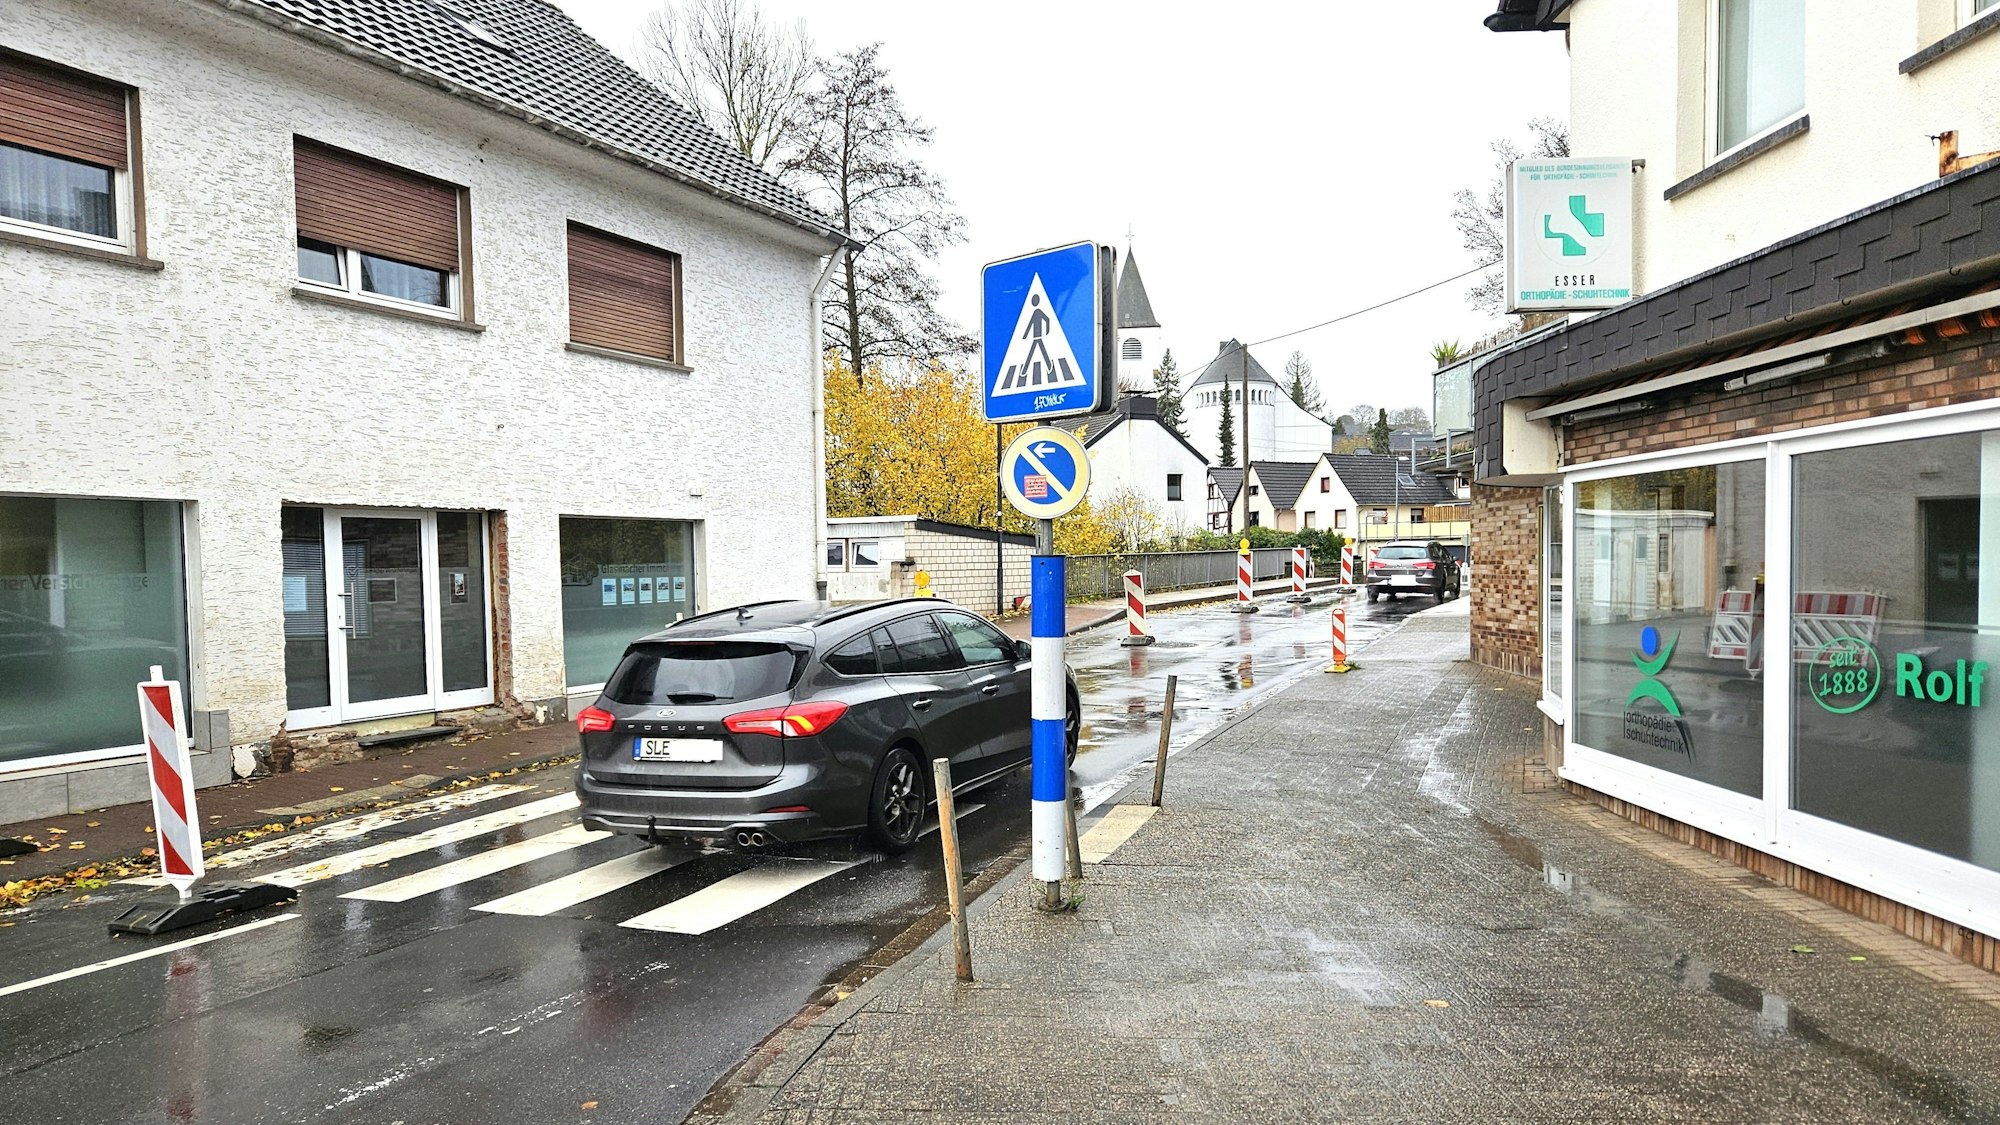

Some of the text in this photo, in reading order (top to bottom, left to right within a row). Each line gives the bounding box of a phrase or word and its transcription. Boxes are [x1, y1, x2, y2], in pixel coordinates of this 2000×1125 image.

[1555, 274, 1595, 287] ESSER
[1520, 288, 1567, 300] ORTHOPÄDIE
[1572, 288, 1630, 299] SCHUHTECHNIK
[1829, 645, 1858, 668] seit
[1819, 667, 1868, 697] 1888
[1896, 652, 1989, 707] Rolf
[1625, 710, 1672, 733] orthopädie
[645, 740, 670, 756] SLE
[1626, 727, 1684, 755] schuhtechnik
